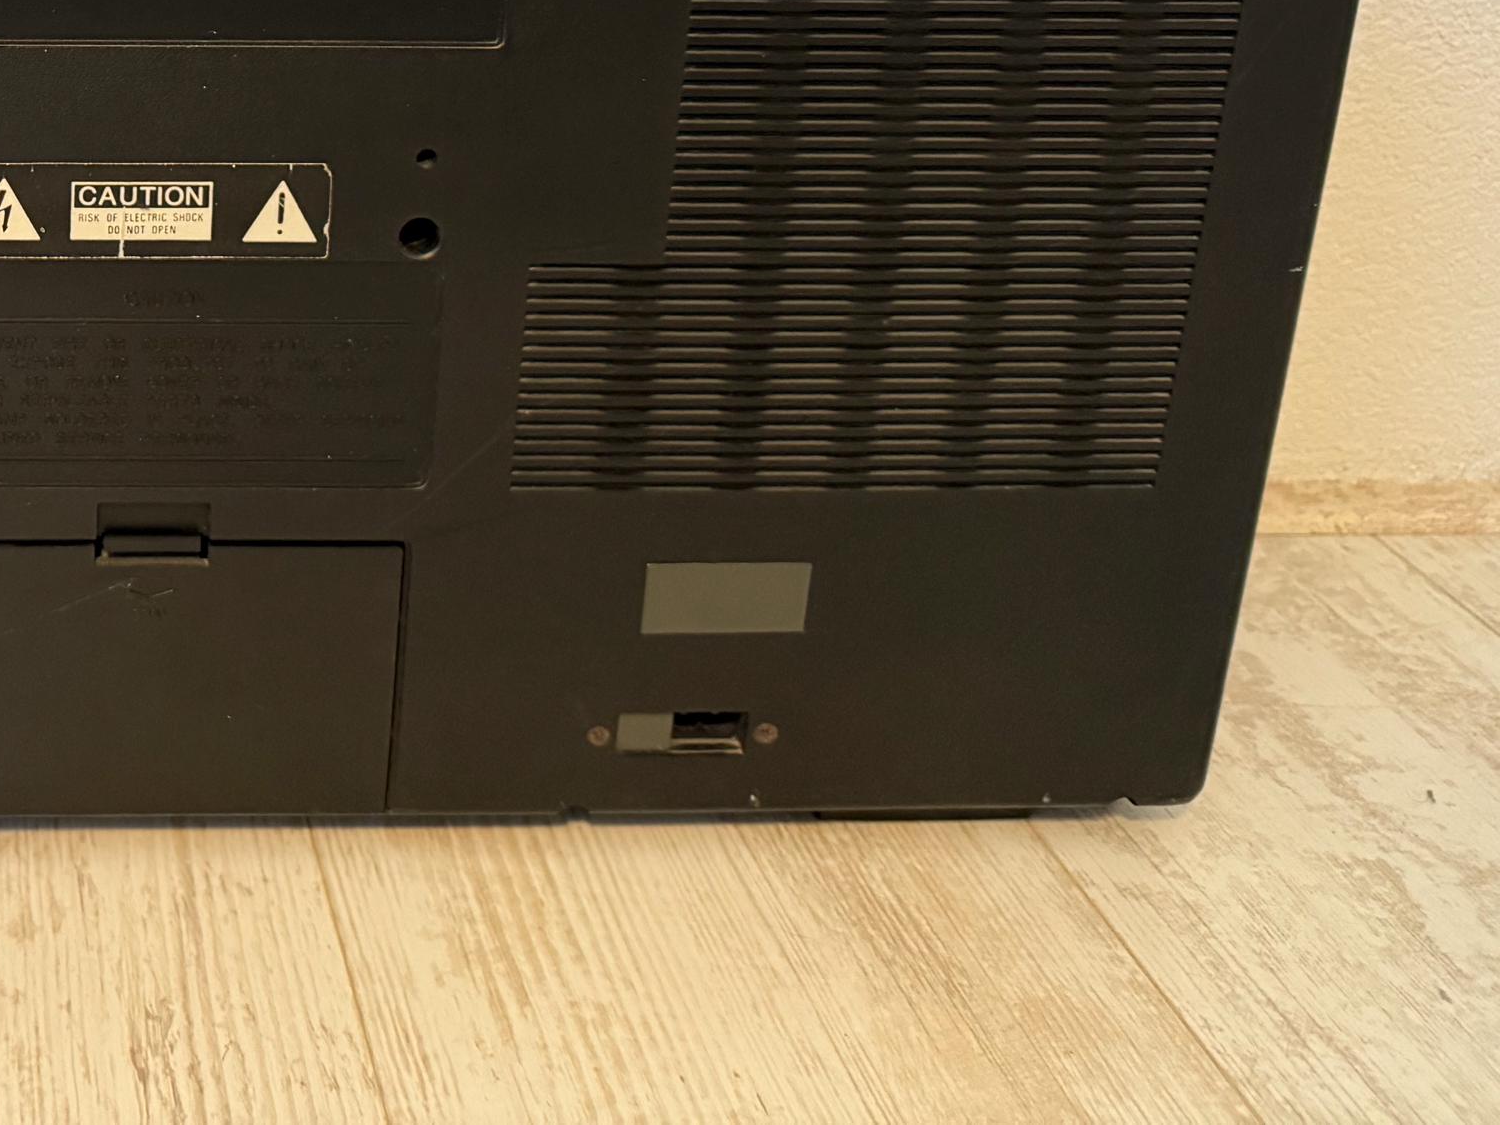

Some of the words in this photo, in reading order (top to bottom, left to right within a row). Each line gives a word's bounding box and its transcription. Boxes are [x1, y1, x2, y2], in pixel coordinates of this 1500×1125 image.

[78, 185, 204, 206] CAUTION
[78, 212, 100, 223] RISK
[106, 212, 118, 223] OF
[124, 212, 167, 223] ELECTRIC
[173, 212, 204, 223] SHOCK
[107, 225, 120, 235] DO
[126, 225, 145, 235] NOT
[151, 225, 177, 235] OPEN
